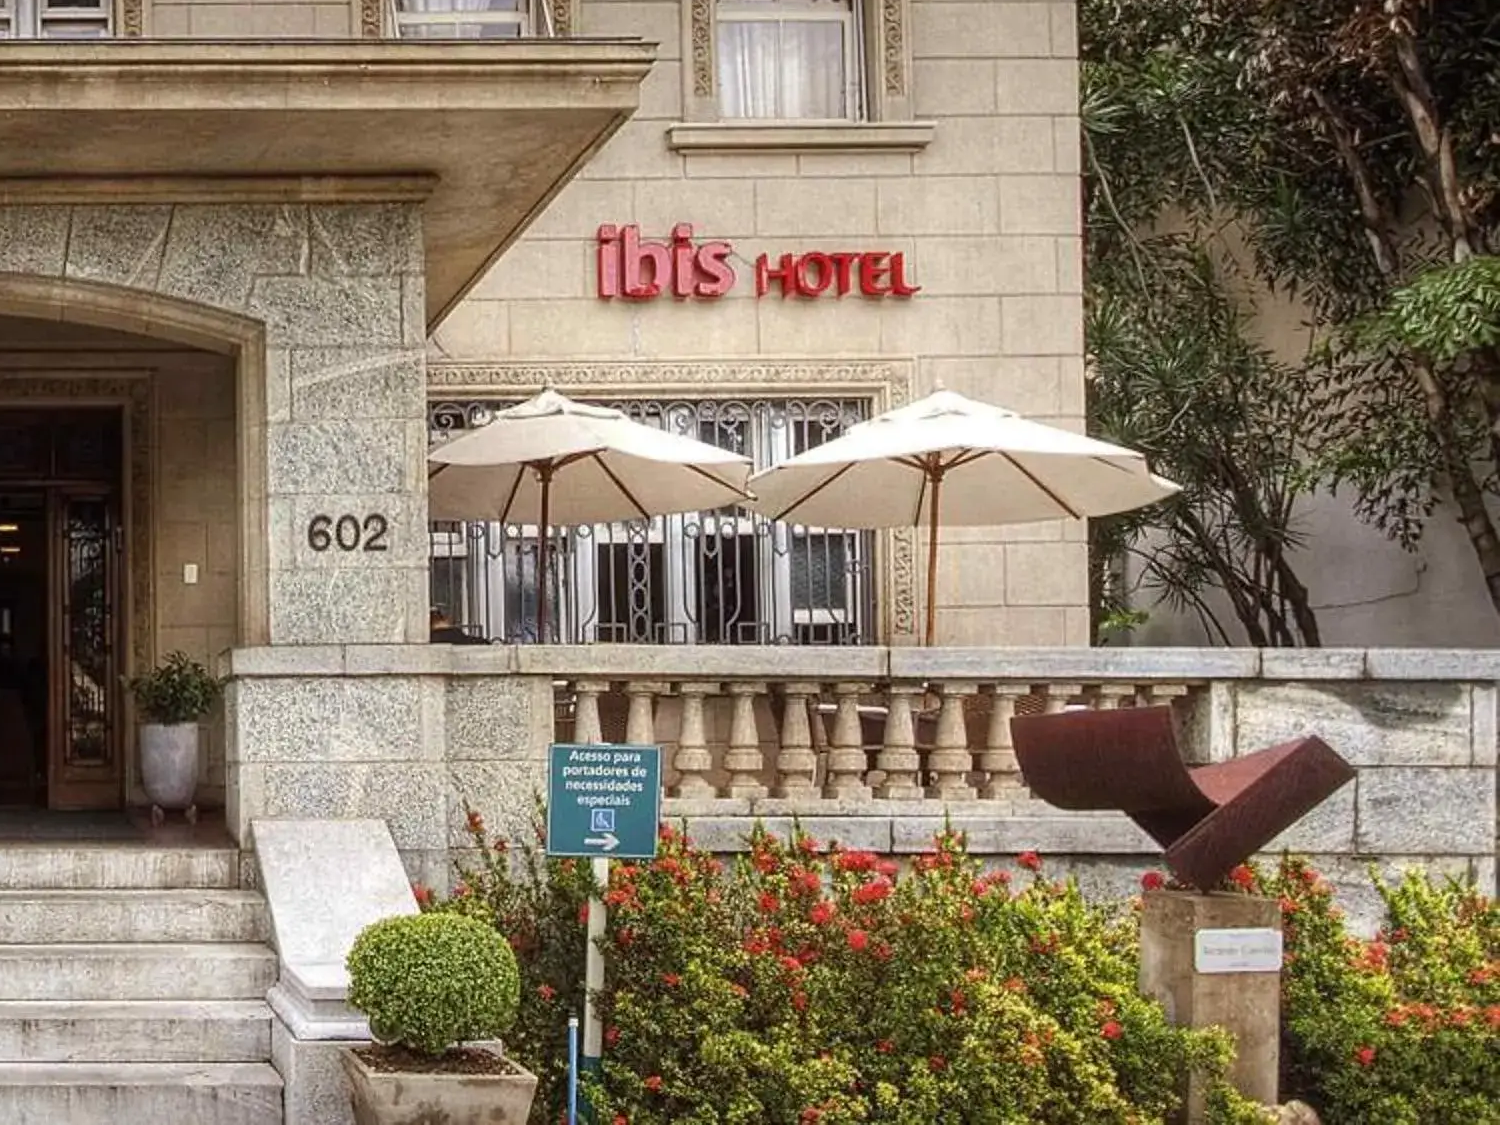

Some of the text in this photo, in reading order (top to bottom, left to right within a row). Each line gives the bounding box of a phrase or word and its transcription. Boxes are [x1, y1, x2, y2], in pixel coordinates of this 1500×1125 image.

[597, 223, 922, 299] ibis HOTEL
[308, 514, 388, 552] 602
[569, 750, 641, 764] Acesso para
[563, 765, 647, 777] portadores de
[565, 780, 643, 792] necessidades
[577, 794, 631, 807] especiais
